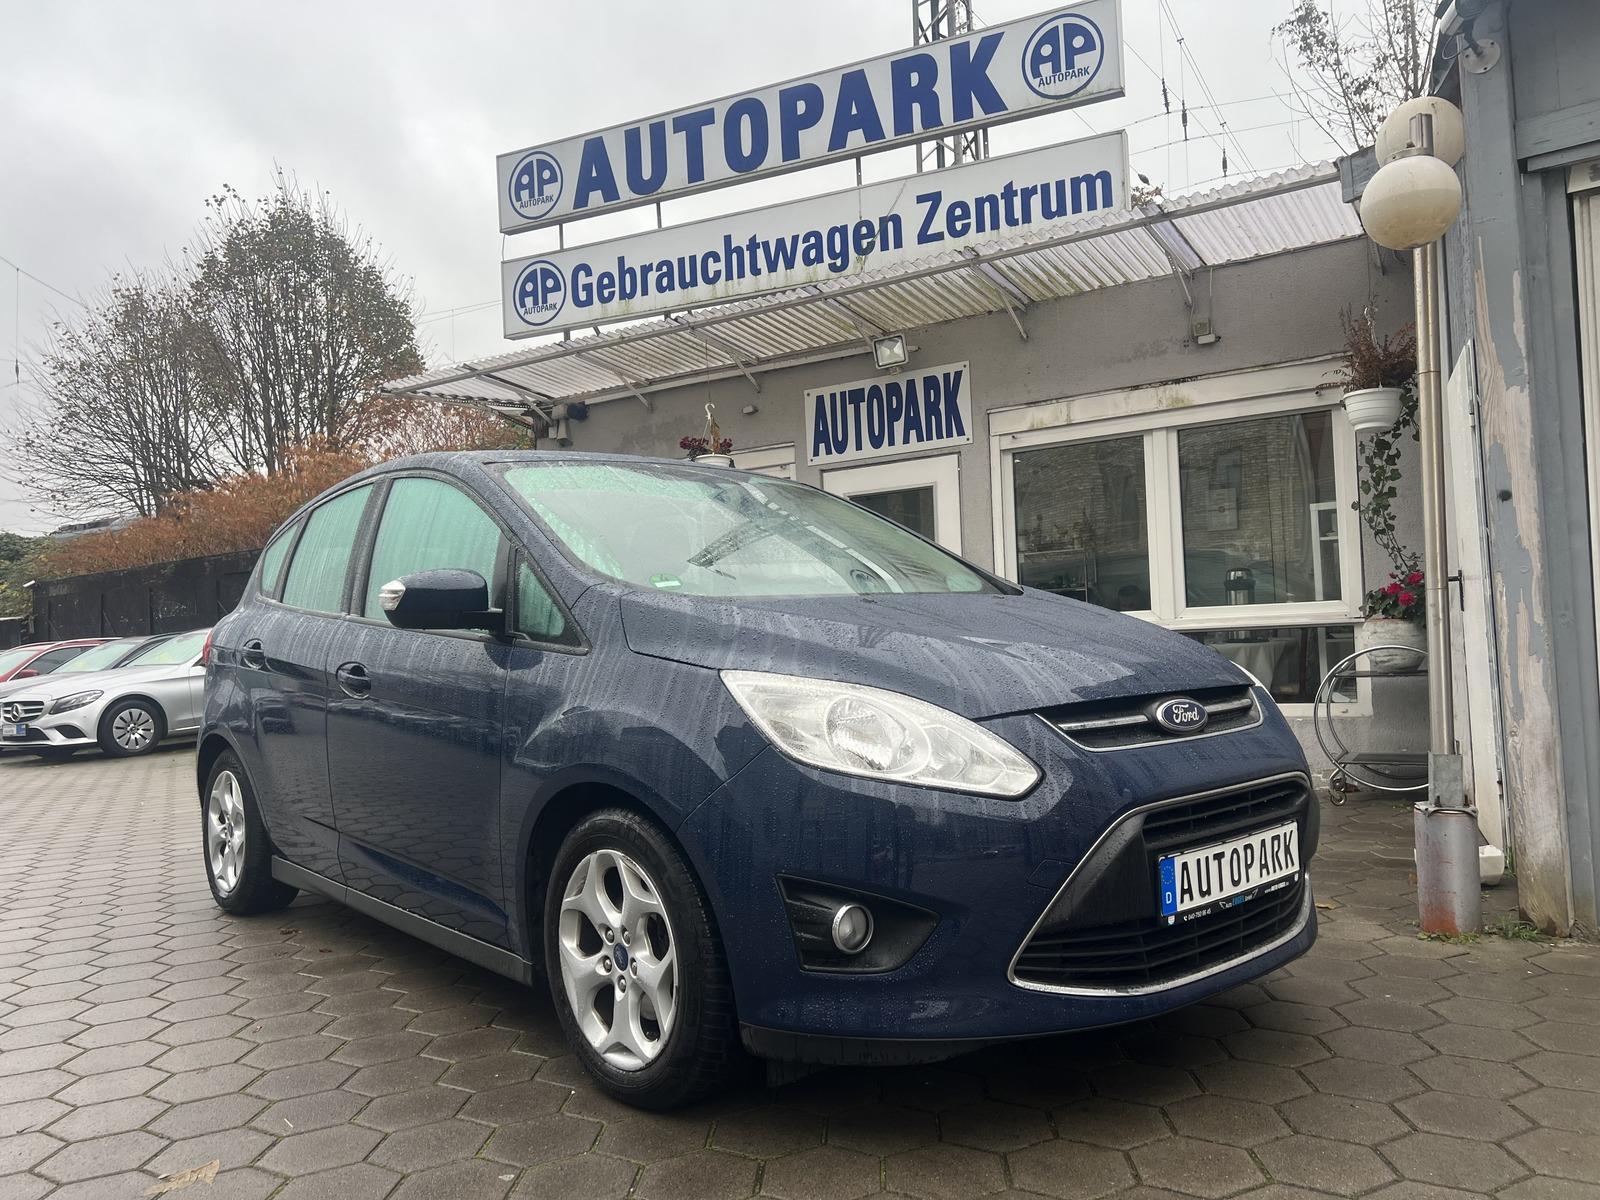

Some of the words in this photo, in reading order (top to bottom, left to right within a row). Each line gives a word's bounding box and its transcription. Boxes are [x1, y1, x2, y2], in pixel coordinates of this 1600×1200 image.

[1038, 66, 1090, 87] AUTOPARK
[572, 31, 1008, 210] AUTOPARK
[519, 194, 554, 209] AUTOPARK
[571, 212, 903, 308] Gebrauchtwagen
[916, 169, 1114, 245] Zentrum
[523, 302, 558, 316] AUTOPARK
[813, 370, 966, 457] AUTOPARK
[1172, 704, 1200, 723] Ford
[1165, 892, 1172, 904] D
[1180, 830, 1295, 904] AUTOPARK
